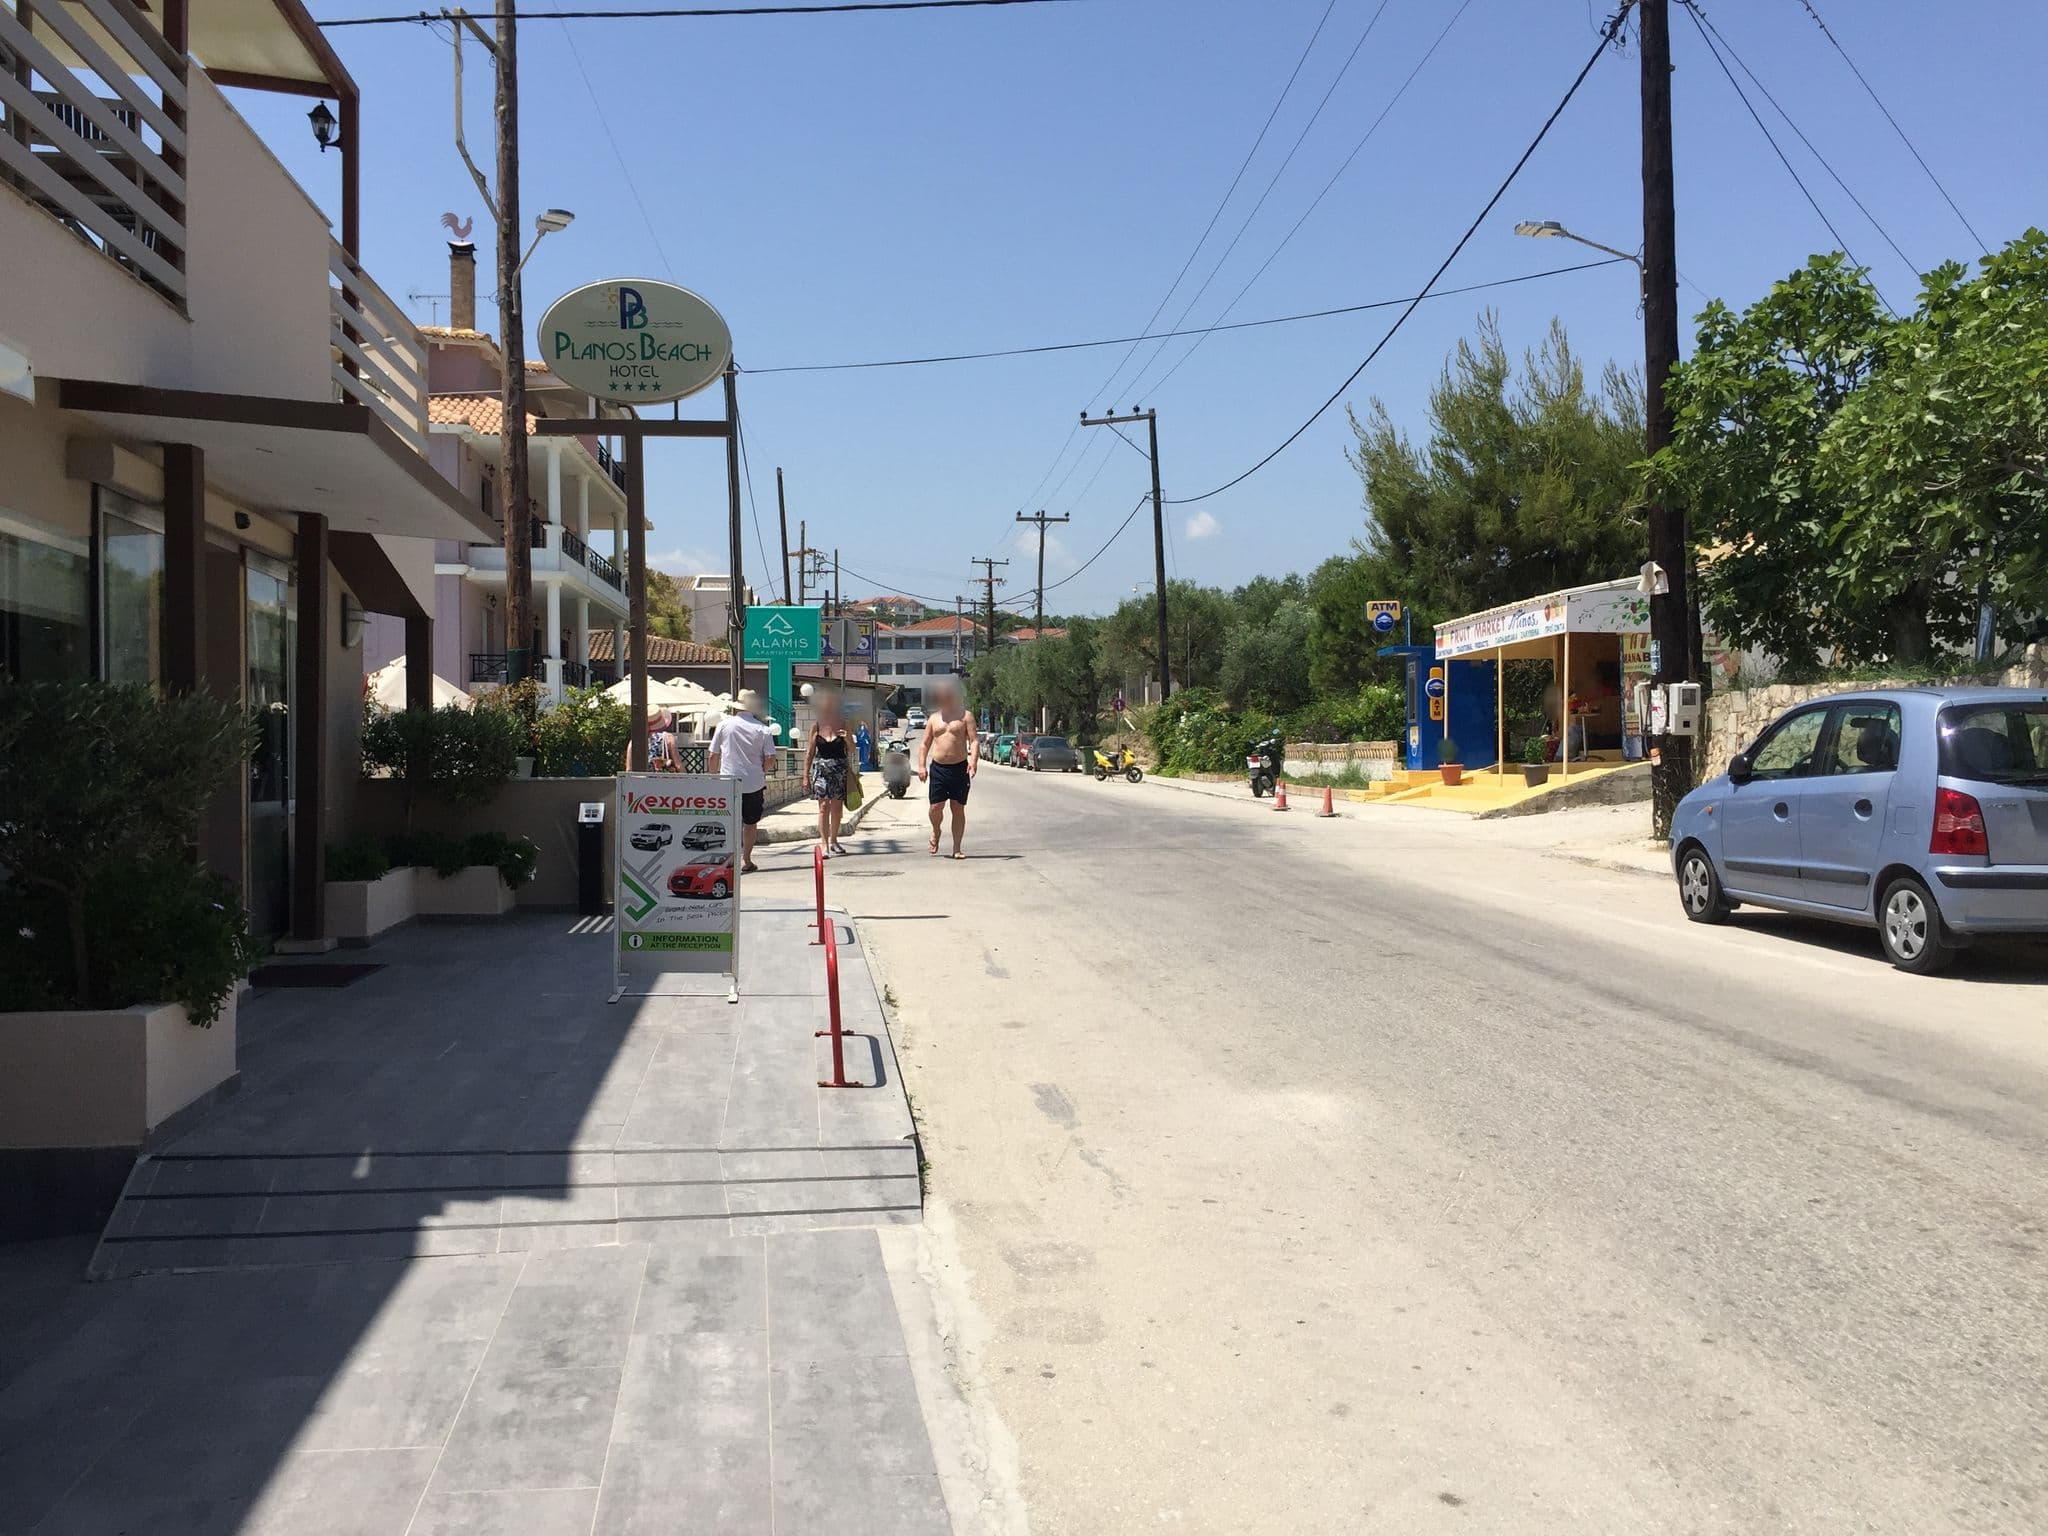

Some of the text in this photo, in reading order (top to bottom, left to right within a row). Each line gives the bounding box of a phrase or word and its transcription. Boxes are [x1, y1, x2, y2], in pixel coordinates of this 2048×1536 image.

[555, 331, 712, 362] PLANOS BEACH
[610, 365, 659, 378] HOTEL
[1371, 602, 1398, 611] ATM
[1450, 625, 1471, 646] FRUIT
[1474, 616, 1506, 638] MARKET
[751, 638, 808, 649] ALAMIS
[1433, 699, 1442, 717] ATM
[652, 935, 719, 943] INFORMATION
